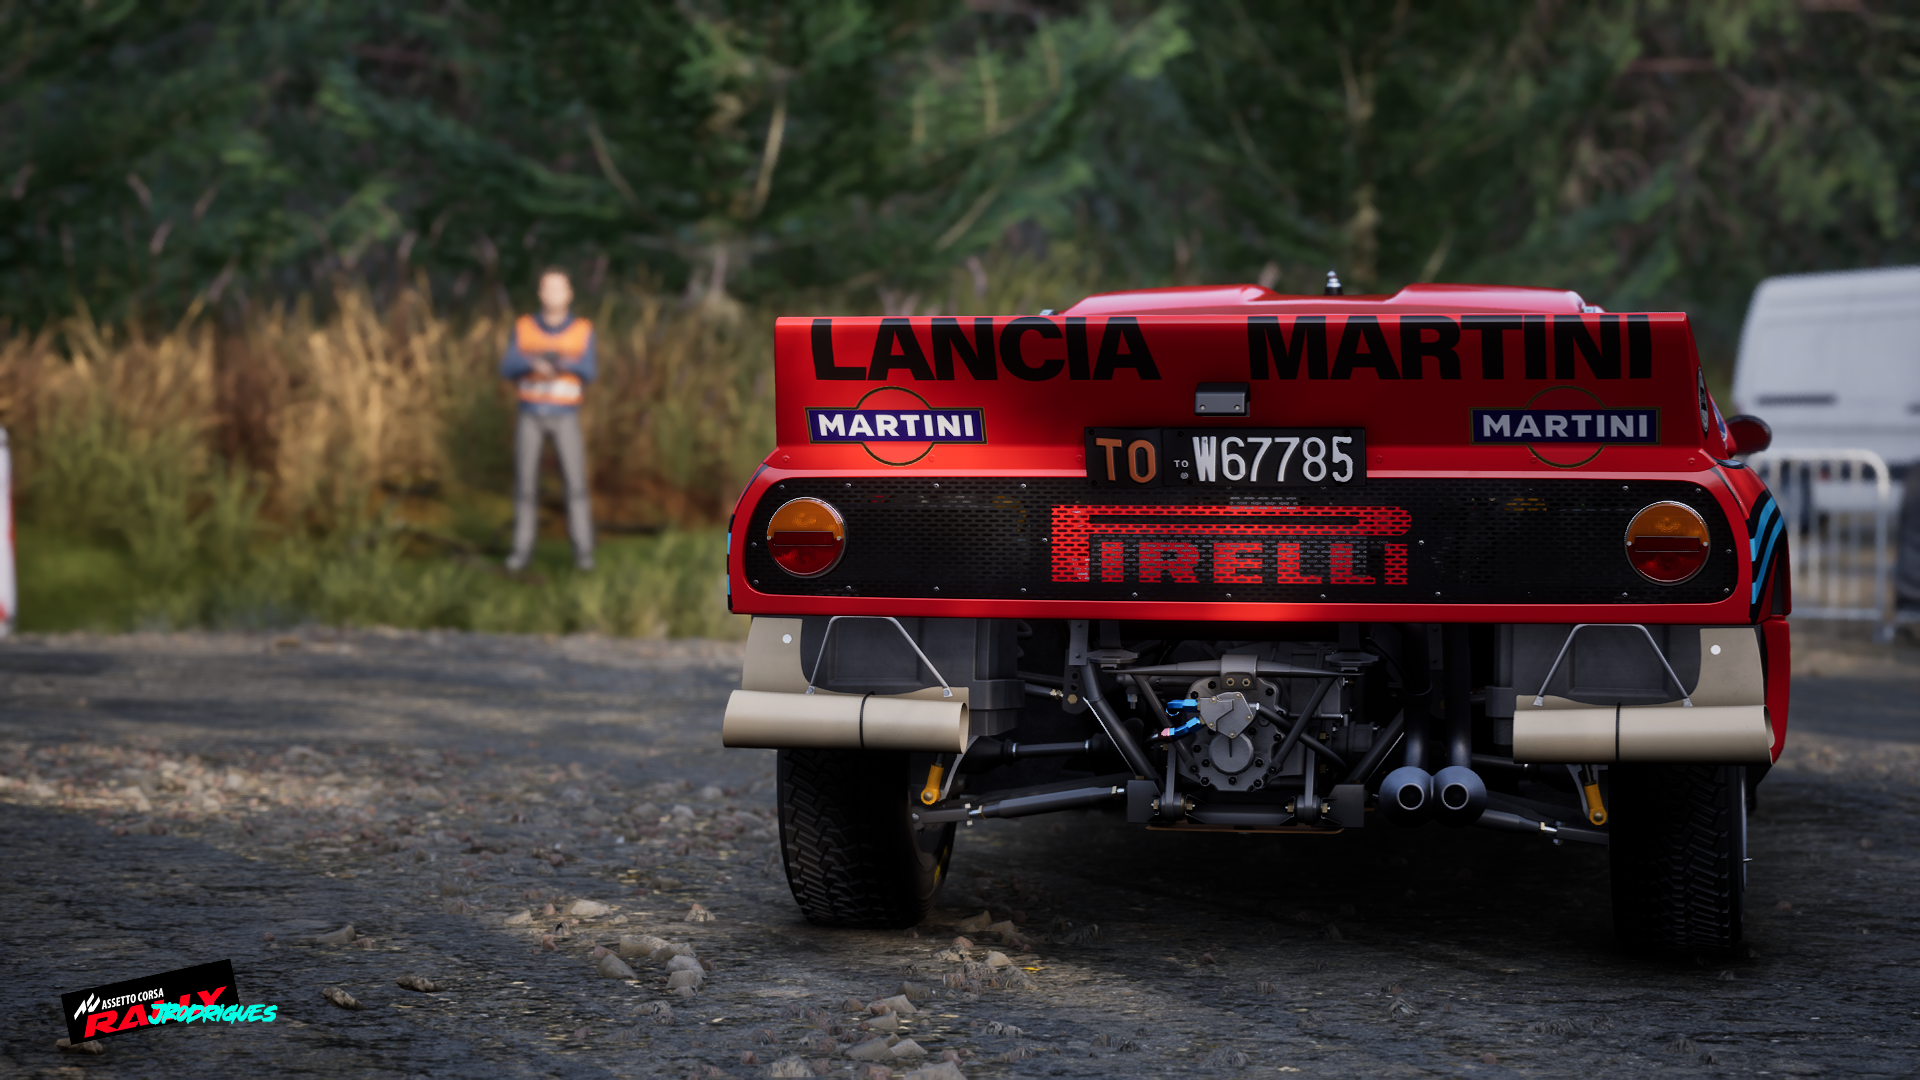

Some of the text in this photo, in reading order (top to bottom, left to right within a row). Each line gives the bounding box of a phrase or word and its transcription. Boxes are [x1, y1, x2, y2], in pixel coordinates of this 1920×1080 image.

[811, 315, 1652, 381] LANCIA MARTINI
[817, 413, 976, 438] MARTINI
[1482, 413, 1649, 438] MARTINI
[1096, 437, 1157, 484] TO
[1192, 435, 1353, 483] W67785
[1051, 504, 1412, 585] PIRELLI
